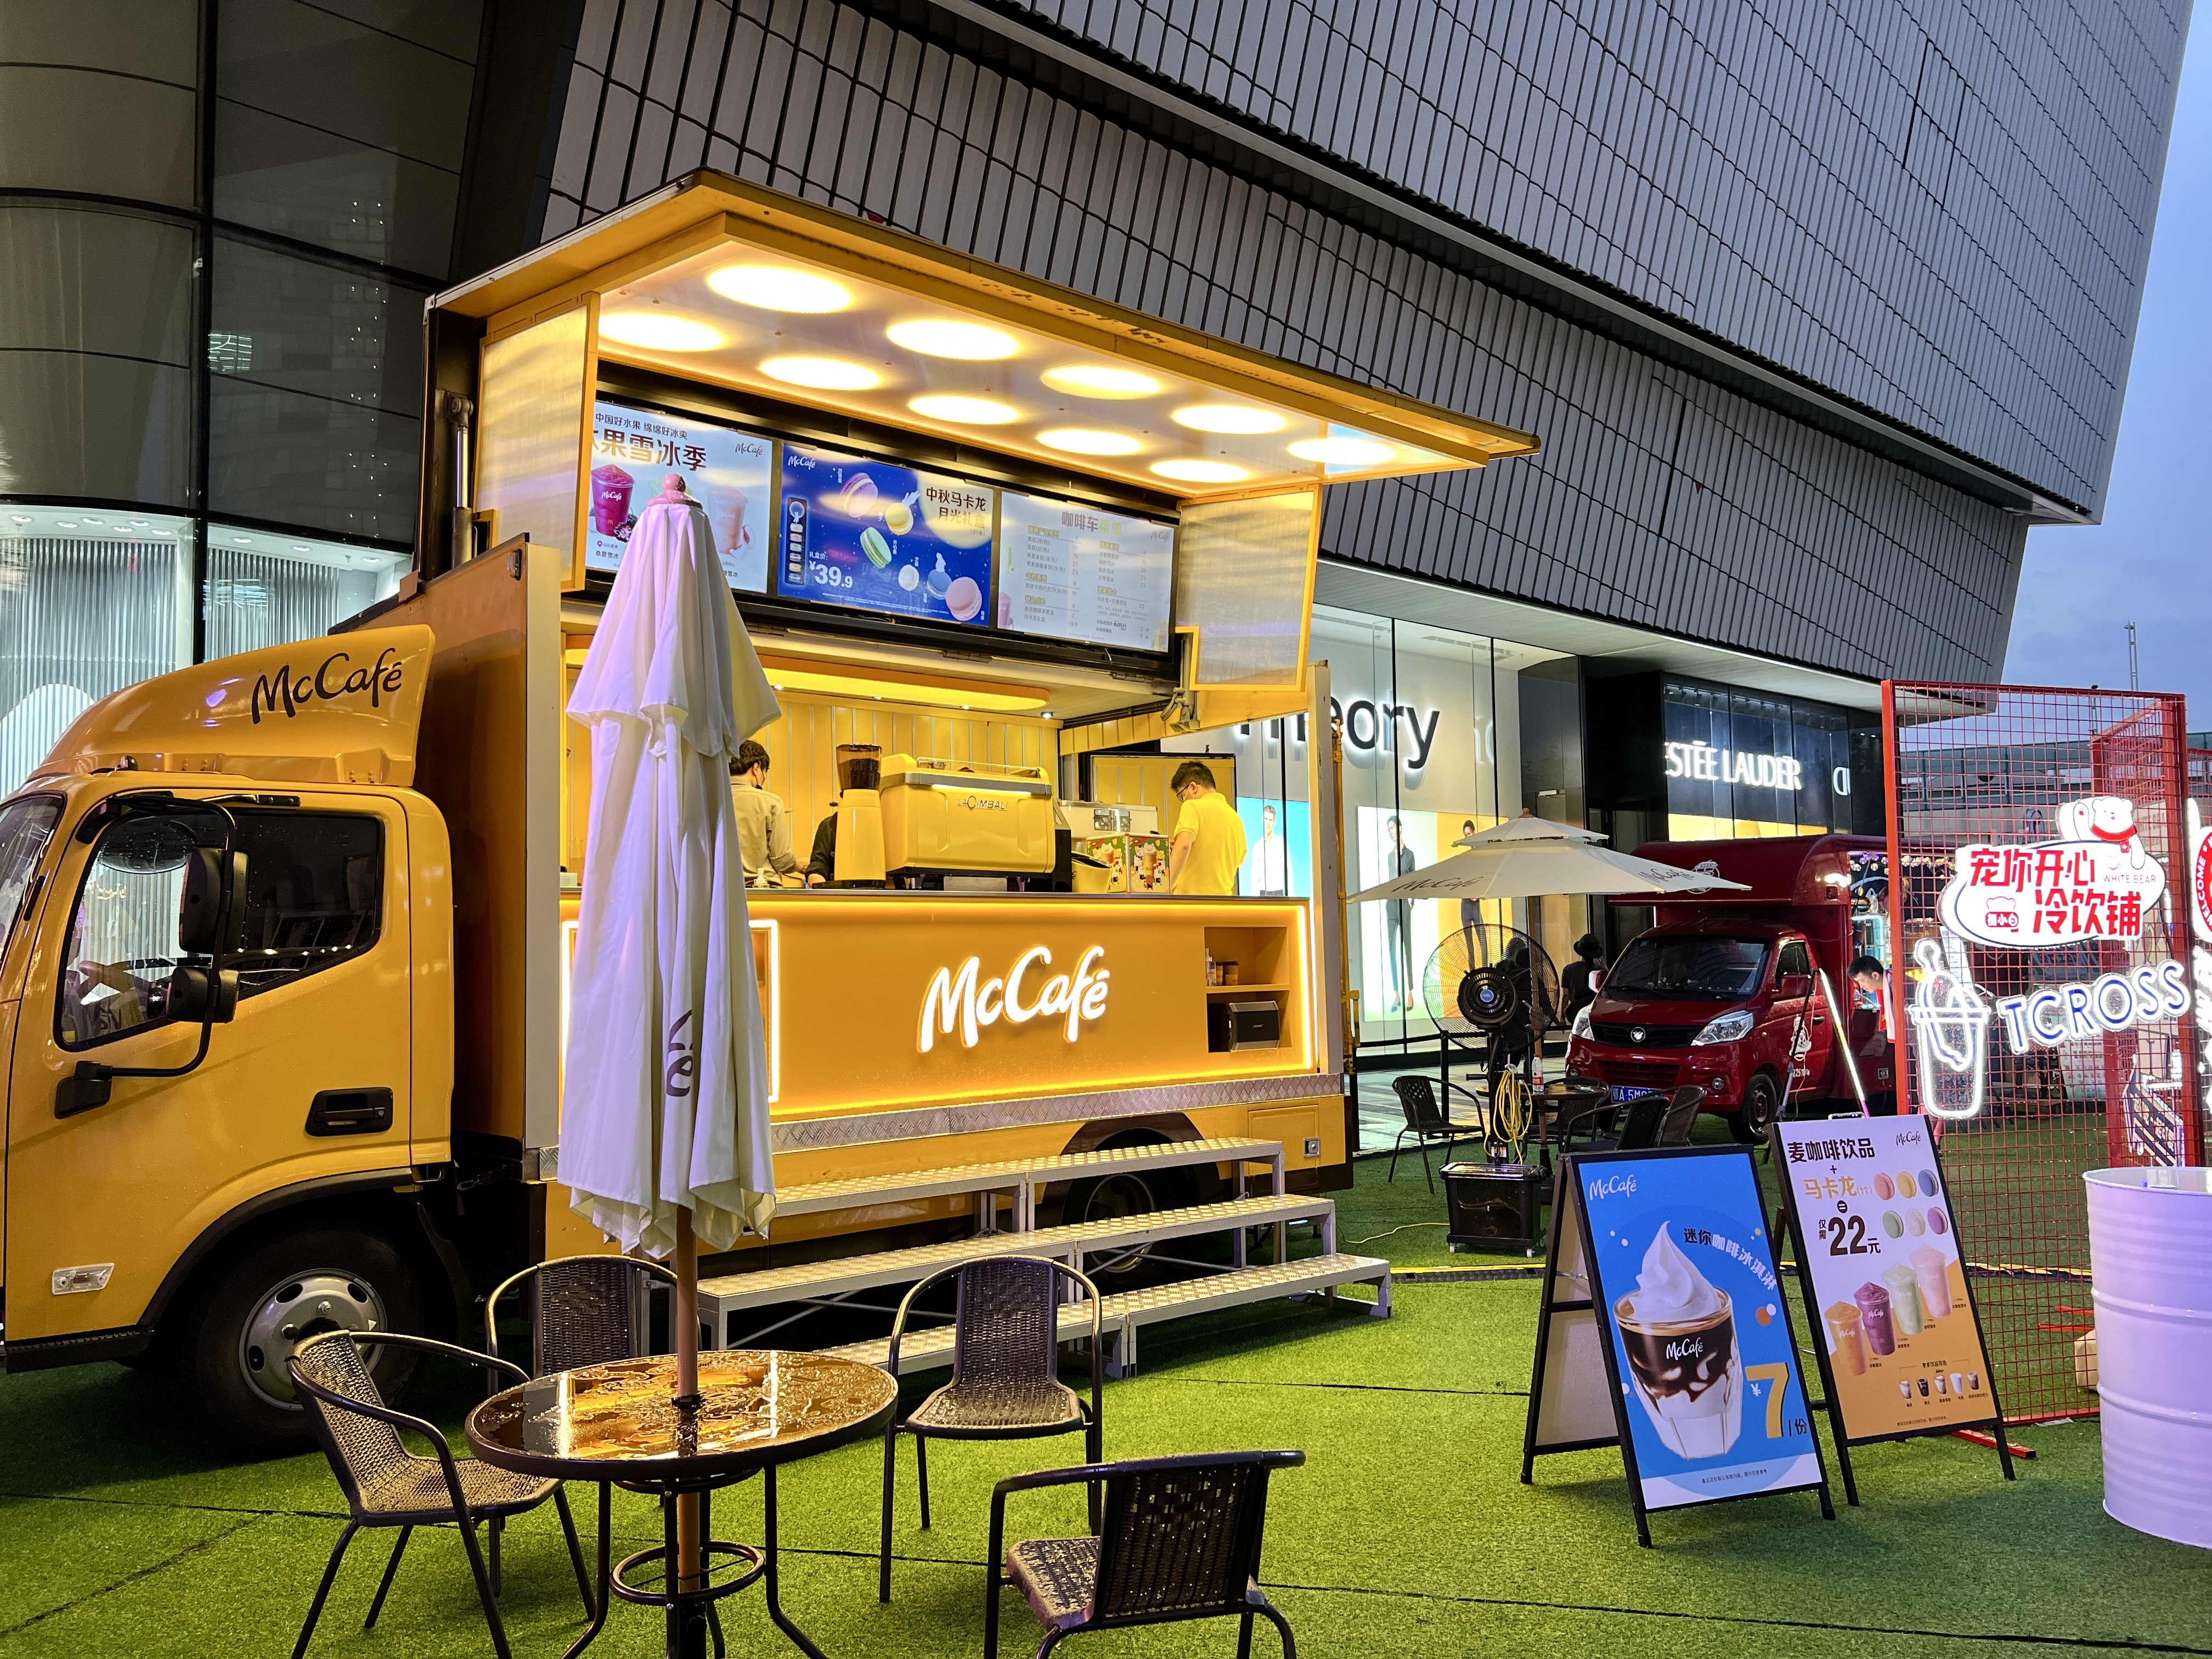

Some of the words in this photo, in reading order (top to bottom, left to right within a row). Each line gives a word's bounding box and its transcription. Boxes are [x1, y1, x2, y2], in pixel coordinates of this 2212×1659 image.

[596, 413, 641, 431] 中国好水果
[644, 422, 687, 439] 绵绵好冰爽
[788, 455, 816, 469] McCafé
[926, 487, 986, 512] 中秋马卡龙
[938, 506, 985, 529] 月光礼盒
[252, 647, 403, 725] McCafé
[1971, 849, 2095, 893] 宠你开心
[2103, 876, 2130, 884] WHITE
[2133, 874, 2157, 884] BEAR
[2033, 889, 2141, 936] 冷饮铺
[917, 945, 1111, 1054] McCafé
[2000, 961, 2188, 1053] TCROSS
[1787, 1138, 1875, 1164] 麦咖啡饮品
[1896, 1131, 1921, 1146] McCafé
[1590, 1174, 1637, 1201] McCafé
[1683, 1227, 1777, 1291] 迷你咖啡冰淇淋
[1665, 1337, 1703, 1361] McCafé
